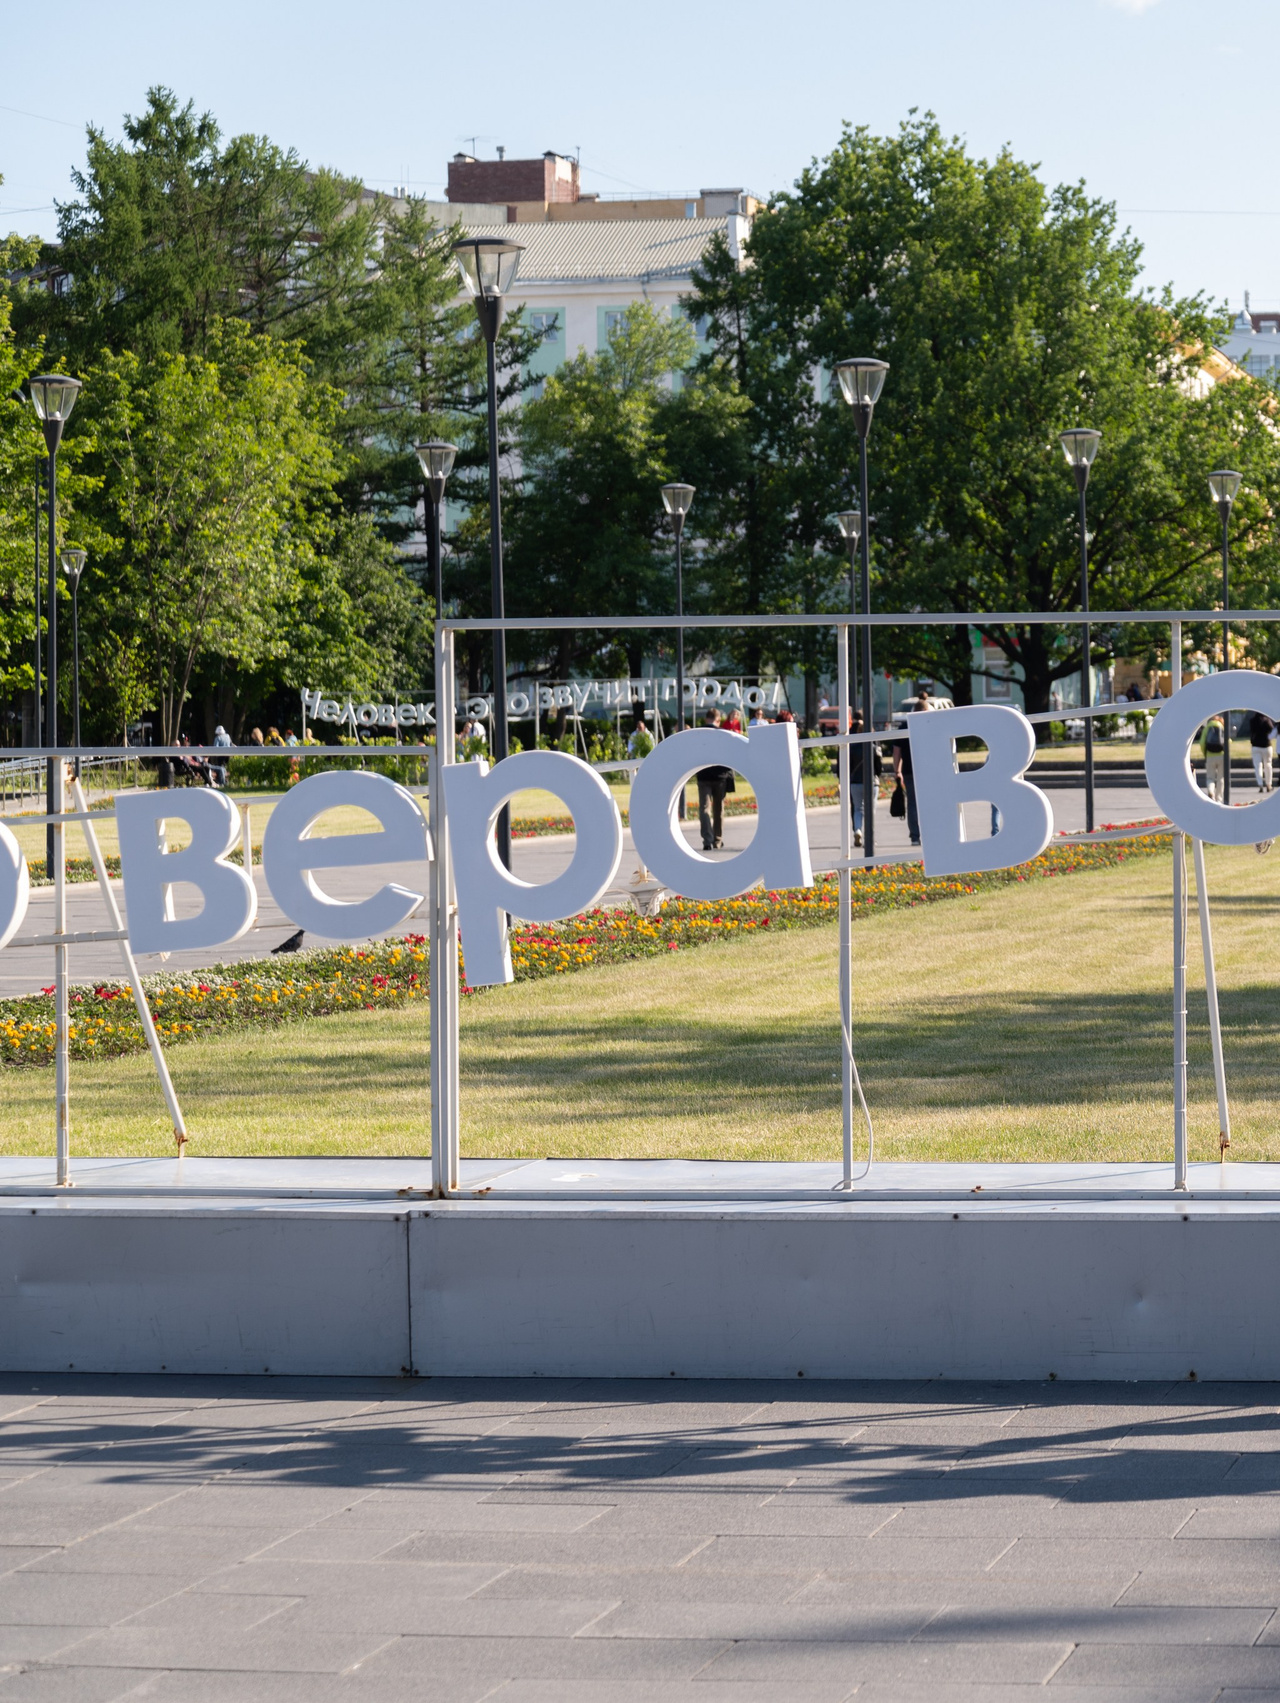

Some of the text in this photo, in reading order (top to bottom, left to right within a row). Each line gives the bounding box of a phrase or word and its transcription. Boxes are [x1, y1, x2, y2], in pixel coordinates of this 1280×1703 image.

[301, 677, 779, 726] Человек эо звучит гордо!
[115, 721, 814, 986] вера
[907, 704, 1055, 877] в
